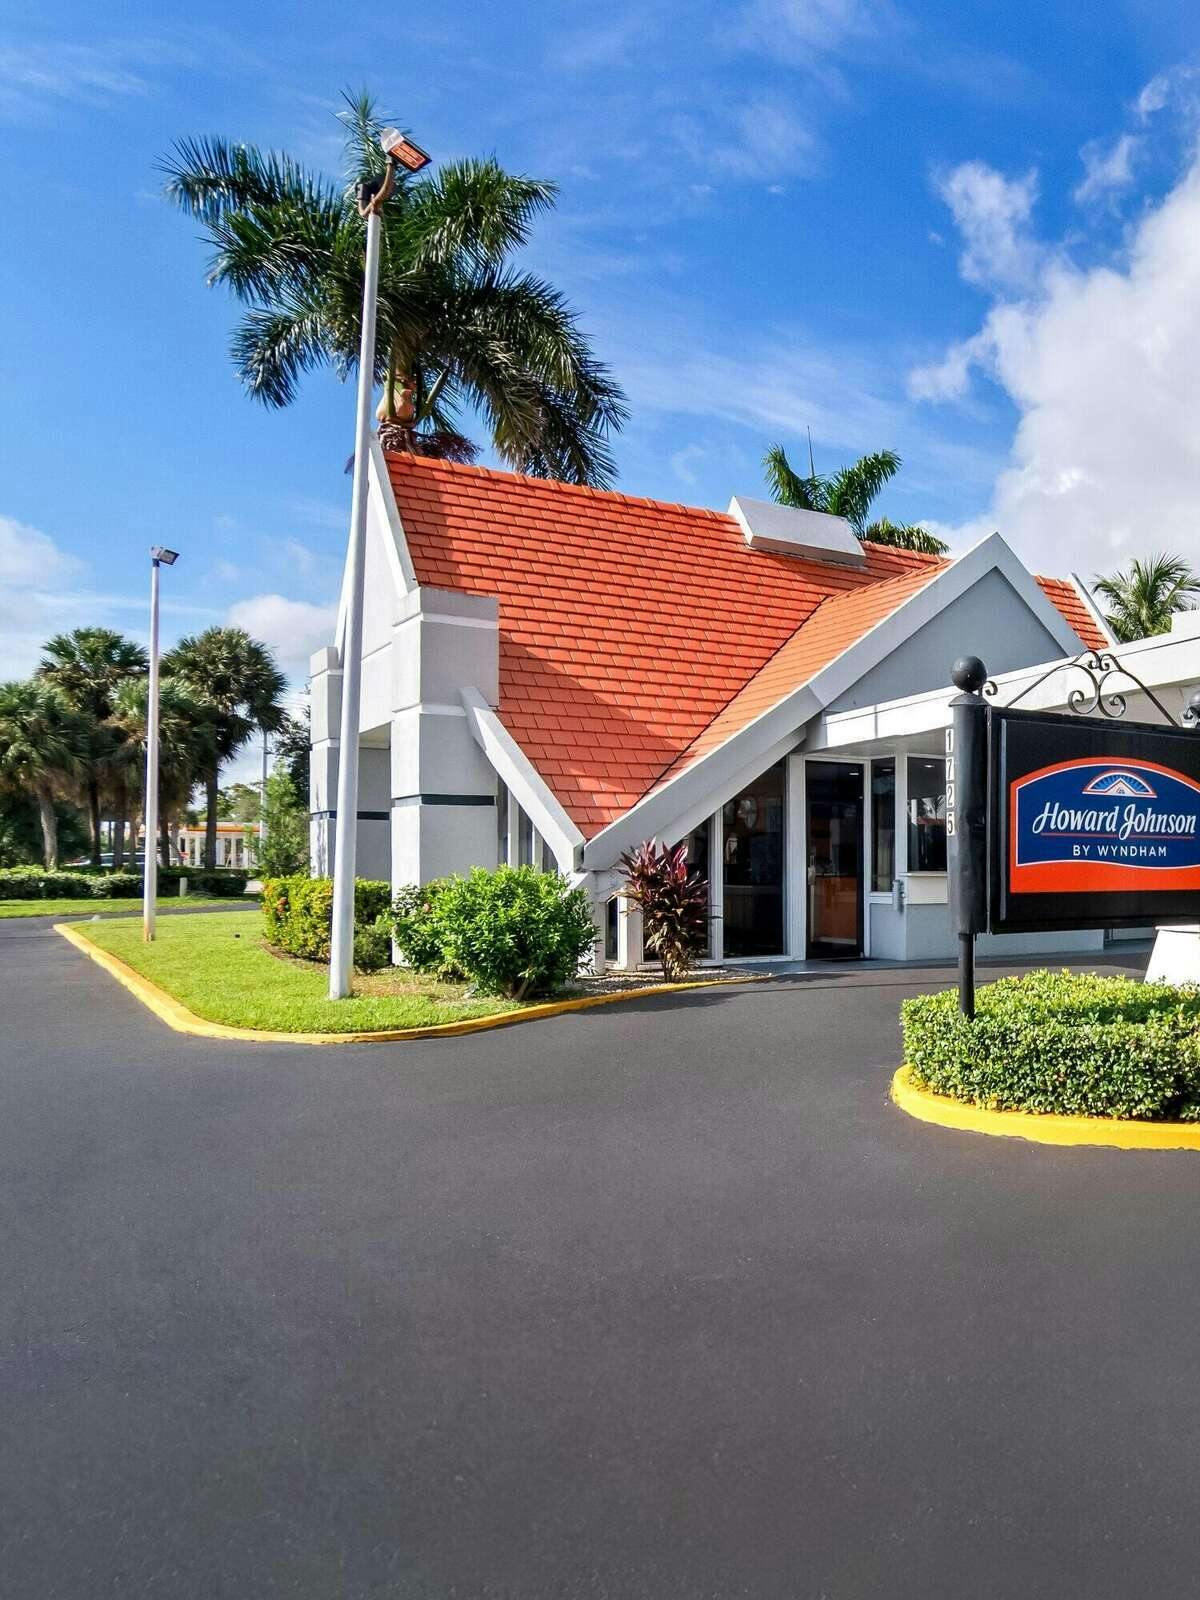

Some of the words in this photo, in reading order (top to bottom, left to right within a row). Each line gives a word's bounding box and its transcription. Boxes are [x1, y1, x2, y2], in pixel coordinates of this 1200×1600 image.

[945, 729, 955, 835] 1725
[1032, 802, 1120, 834] Howard
[1119, 803, 1197, 840] Johnson
[1073, 845, 1090, 856] BY
[1097, 846, 1167, 857] WYNDHAM
